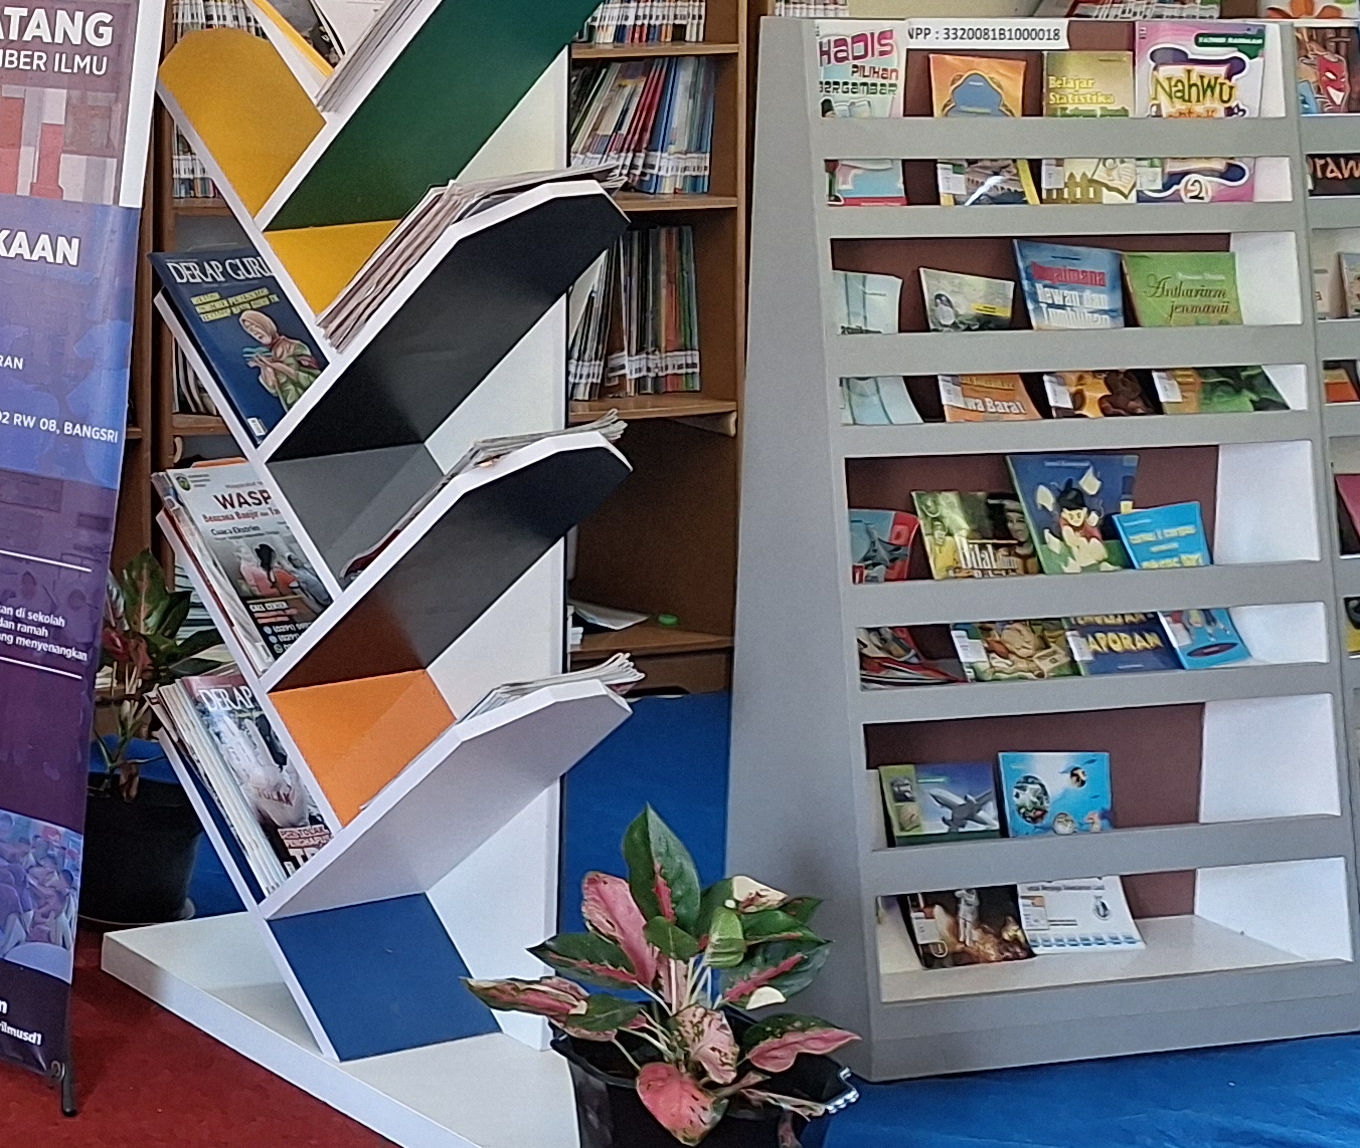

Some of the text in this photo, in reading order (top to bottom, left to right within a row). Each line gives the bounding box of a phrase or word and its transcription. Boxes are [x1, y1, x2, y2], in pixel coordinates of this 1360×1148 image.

[943, 28, 1061, 41] 3320081B1000018
[53, 52, 108, 76] ILMU
[1048, 77, 1096, 90] Belajar
[1048, 92, 1115, 105] Statistika
[167, 260, 225, 283] DERAP
[12, 412, 37, 429] RW
[39, 417, 60, 434] 08,
[63, 420, 118, 443] BANGSRI
[199, 686, 255, 710] DERAP
